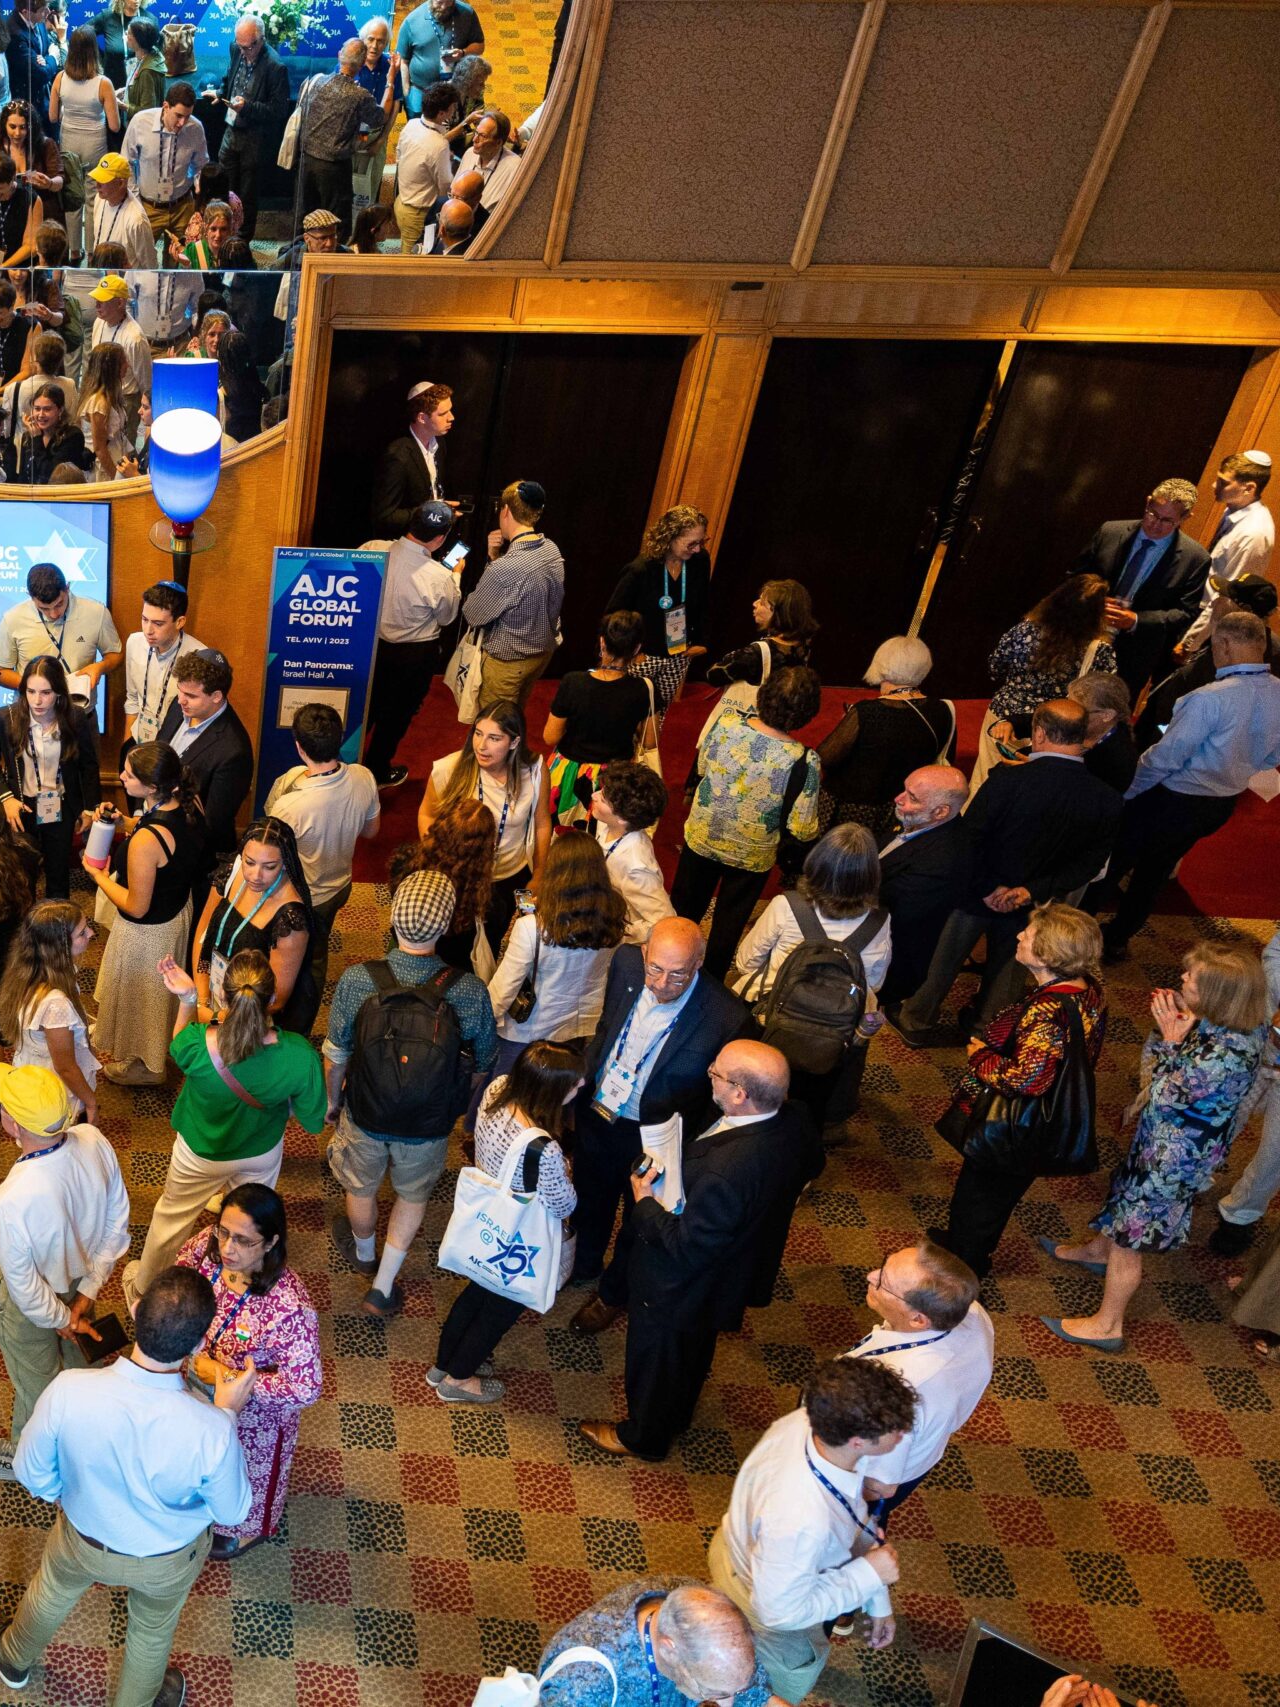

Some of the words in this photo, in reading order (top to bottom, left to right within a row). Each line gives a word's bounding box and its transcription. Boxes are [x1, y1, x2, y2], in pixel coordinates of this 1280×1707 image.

[428, 512, 443, 523] AJC
[290, 574, 360, 598] AJC
[289, 599, 361, 613] GLOBAL
[288, 613, 353, 627] FORUM
[283, 660, 302, 668] Dan
[304, 660, 354, 670] Panorama:
[283, 670, 306, 678] Israel
[308, 671, 325, 679] Hall
[476, 1211, 516, 1244] ISRAEL
[480, 1228, 494, 1246] @
[469, 1255, 483, 1268] AJC
[487, 1238, 527, 1275] 75
